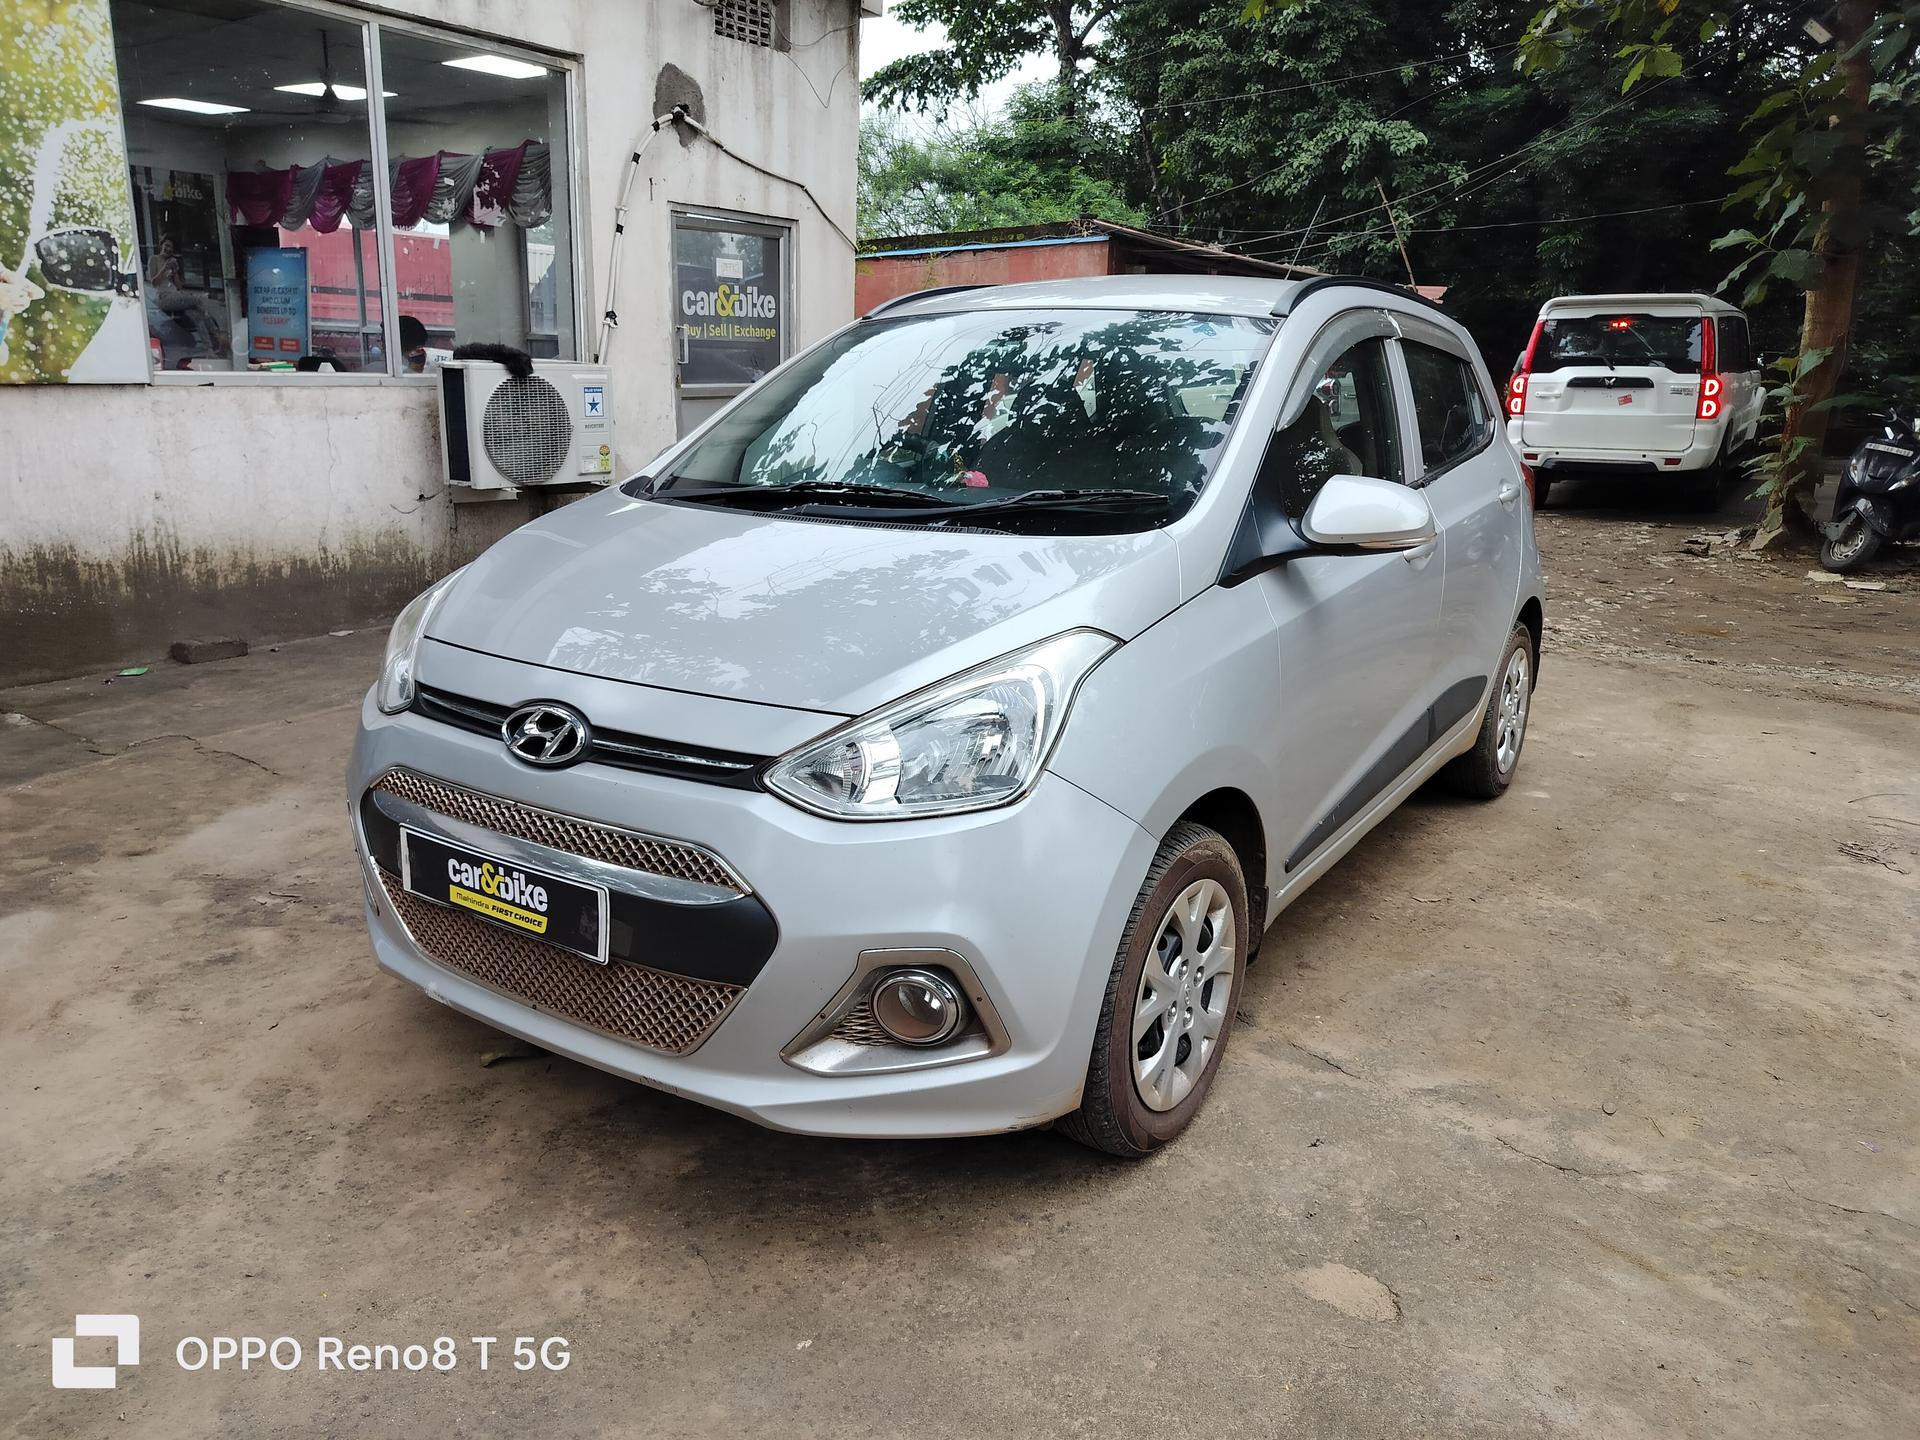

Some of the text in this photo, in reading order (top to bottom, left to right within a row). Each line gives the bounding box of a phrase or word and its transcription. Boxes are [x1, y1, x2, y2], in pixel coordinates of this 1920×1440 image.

[682, 284, 776, 318] car&bike
[684, 324, 776, 340] Buy Sell Exchange
[448, 858, 548, 912] car&bike
[456, 892, 543, 928] Mahindra FIRST CHOICE
